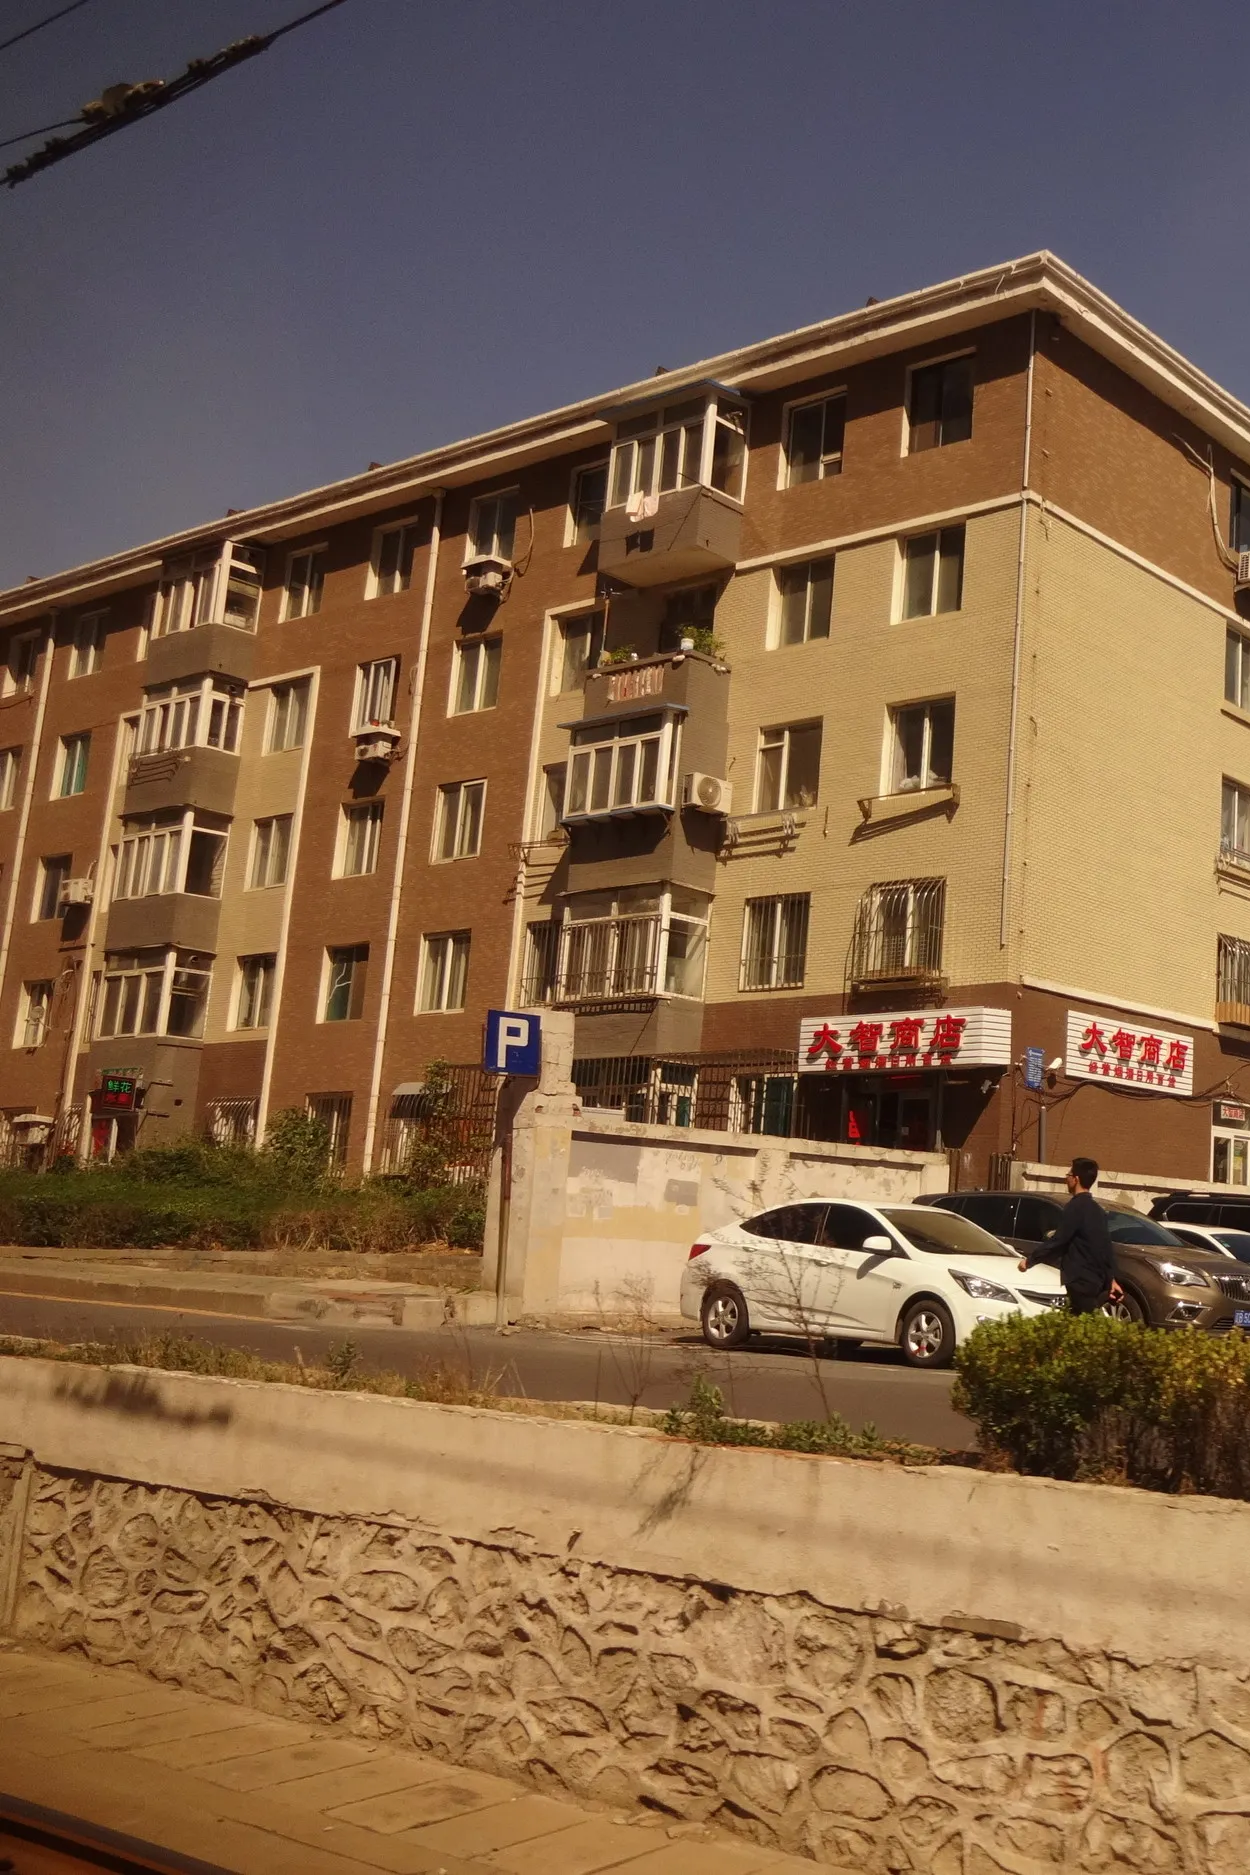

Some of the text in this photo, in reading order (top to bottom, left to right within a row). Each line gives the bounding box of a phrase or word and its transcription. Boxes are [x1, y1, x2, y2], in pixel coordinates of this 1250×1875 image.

[497, 1016, 529, 1068] P
[808, 1014, 967, 1053] 大智商店
[1081, 1021, 1188, 1070] 大智商店
[107, 1080, 133, 1093] 鲜花
